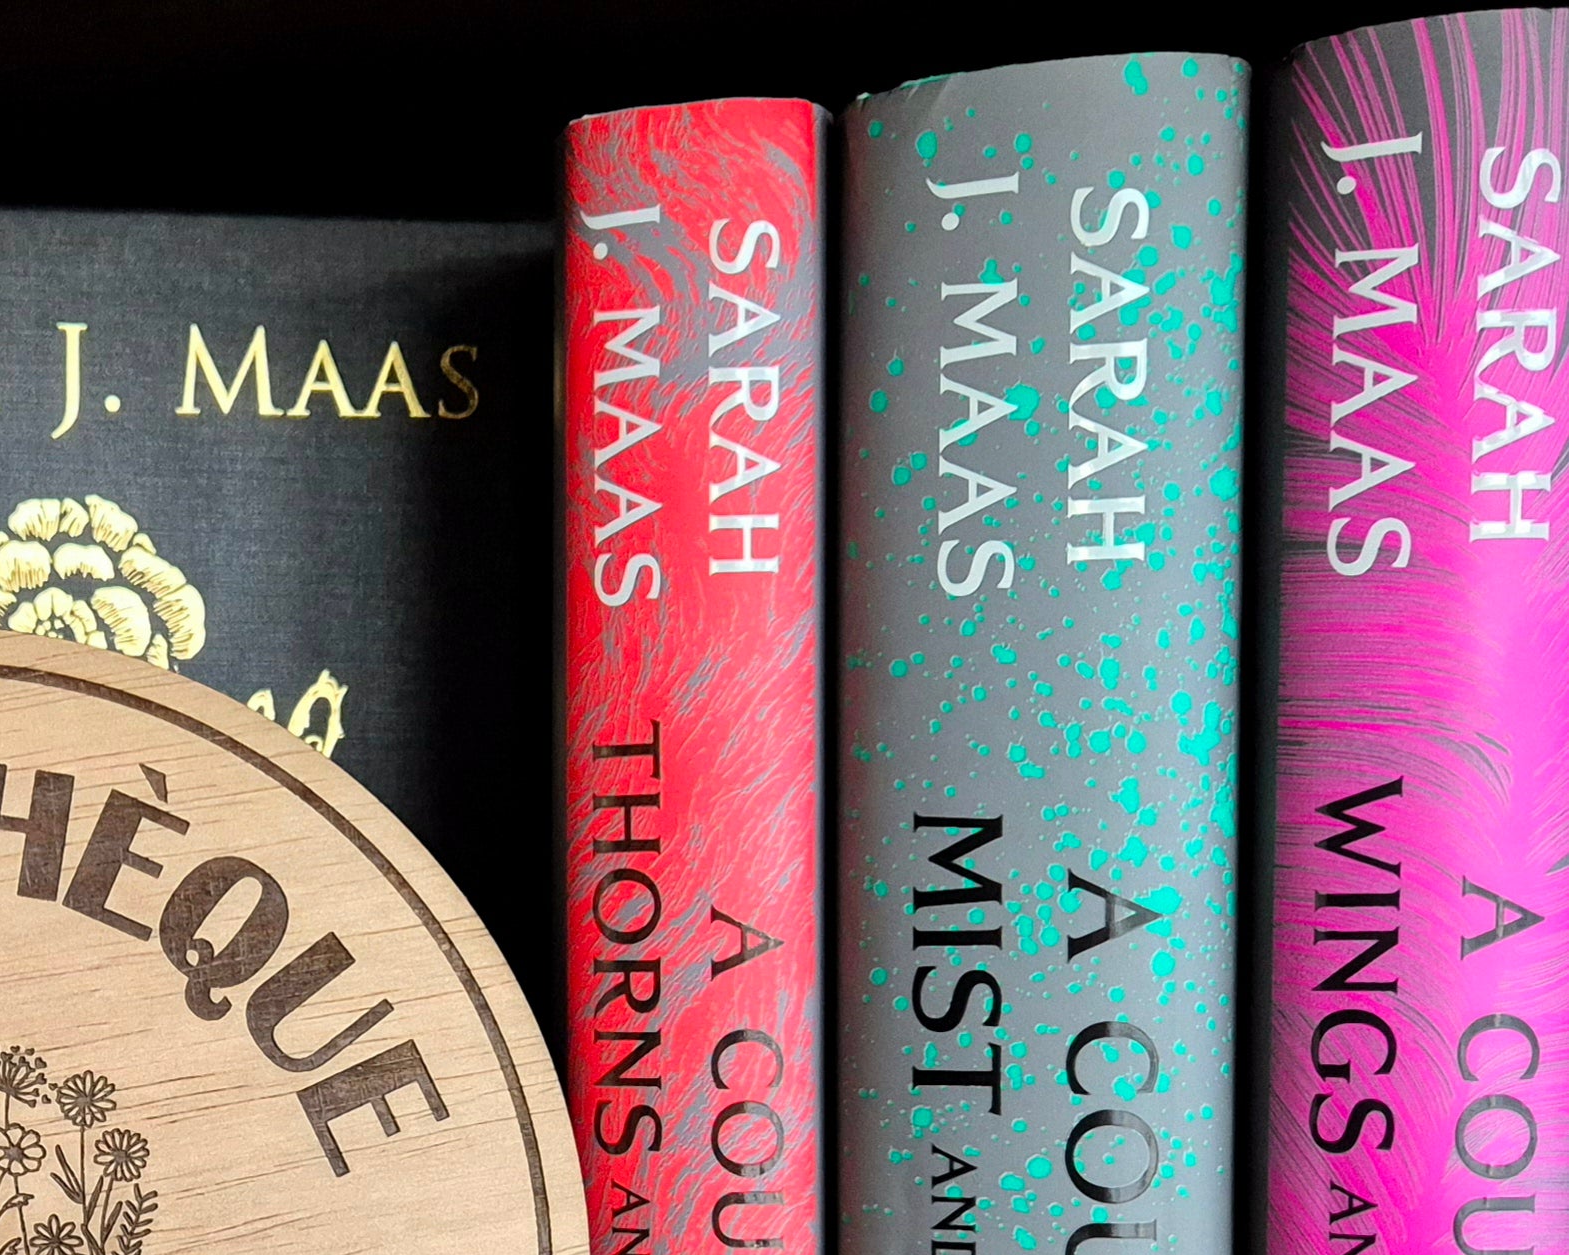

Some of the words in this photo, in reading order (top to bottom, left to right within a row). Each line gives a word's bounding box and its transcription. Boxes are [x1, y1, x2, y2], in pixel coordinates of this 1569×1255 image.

[580, 204, 661, 260] J.
[926, 171, 1020, 232] J.
[1321, 131, 1422, 195] J.
[51, 322, 123, 439] J.
[175, 324, 479, 421] MAAS
[593, 306, 662, 607] MAAS
[708, 218, 780, 576] SARAH
[937, 278, 1019, 597] MAAS
[1066, 186, 1150, 565] SARAH
[1327, 243, 1419, 576] MAAS
[1469, 146, 1561, 541] SARAH
[592, 719, 662, 1156] THORNS
[710, 905, 784, 981] A
[911, 812, 1003, 1116] MIST
[1066, 869, 1163, 961] A
[1309, 775, 1404, 1154] WINGS
[1460, 875, 1545, 961] A
